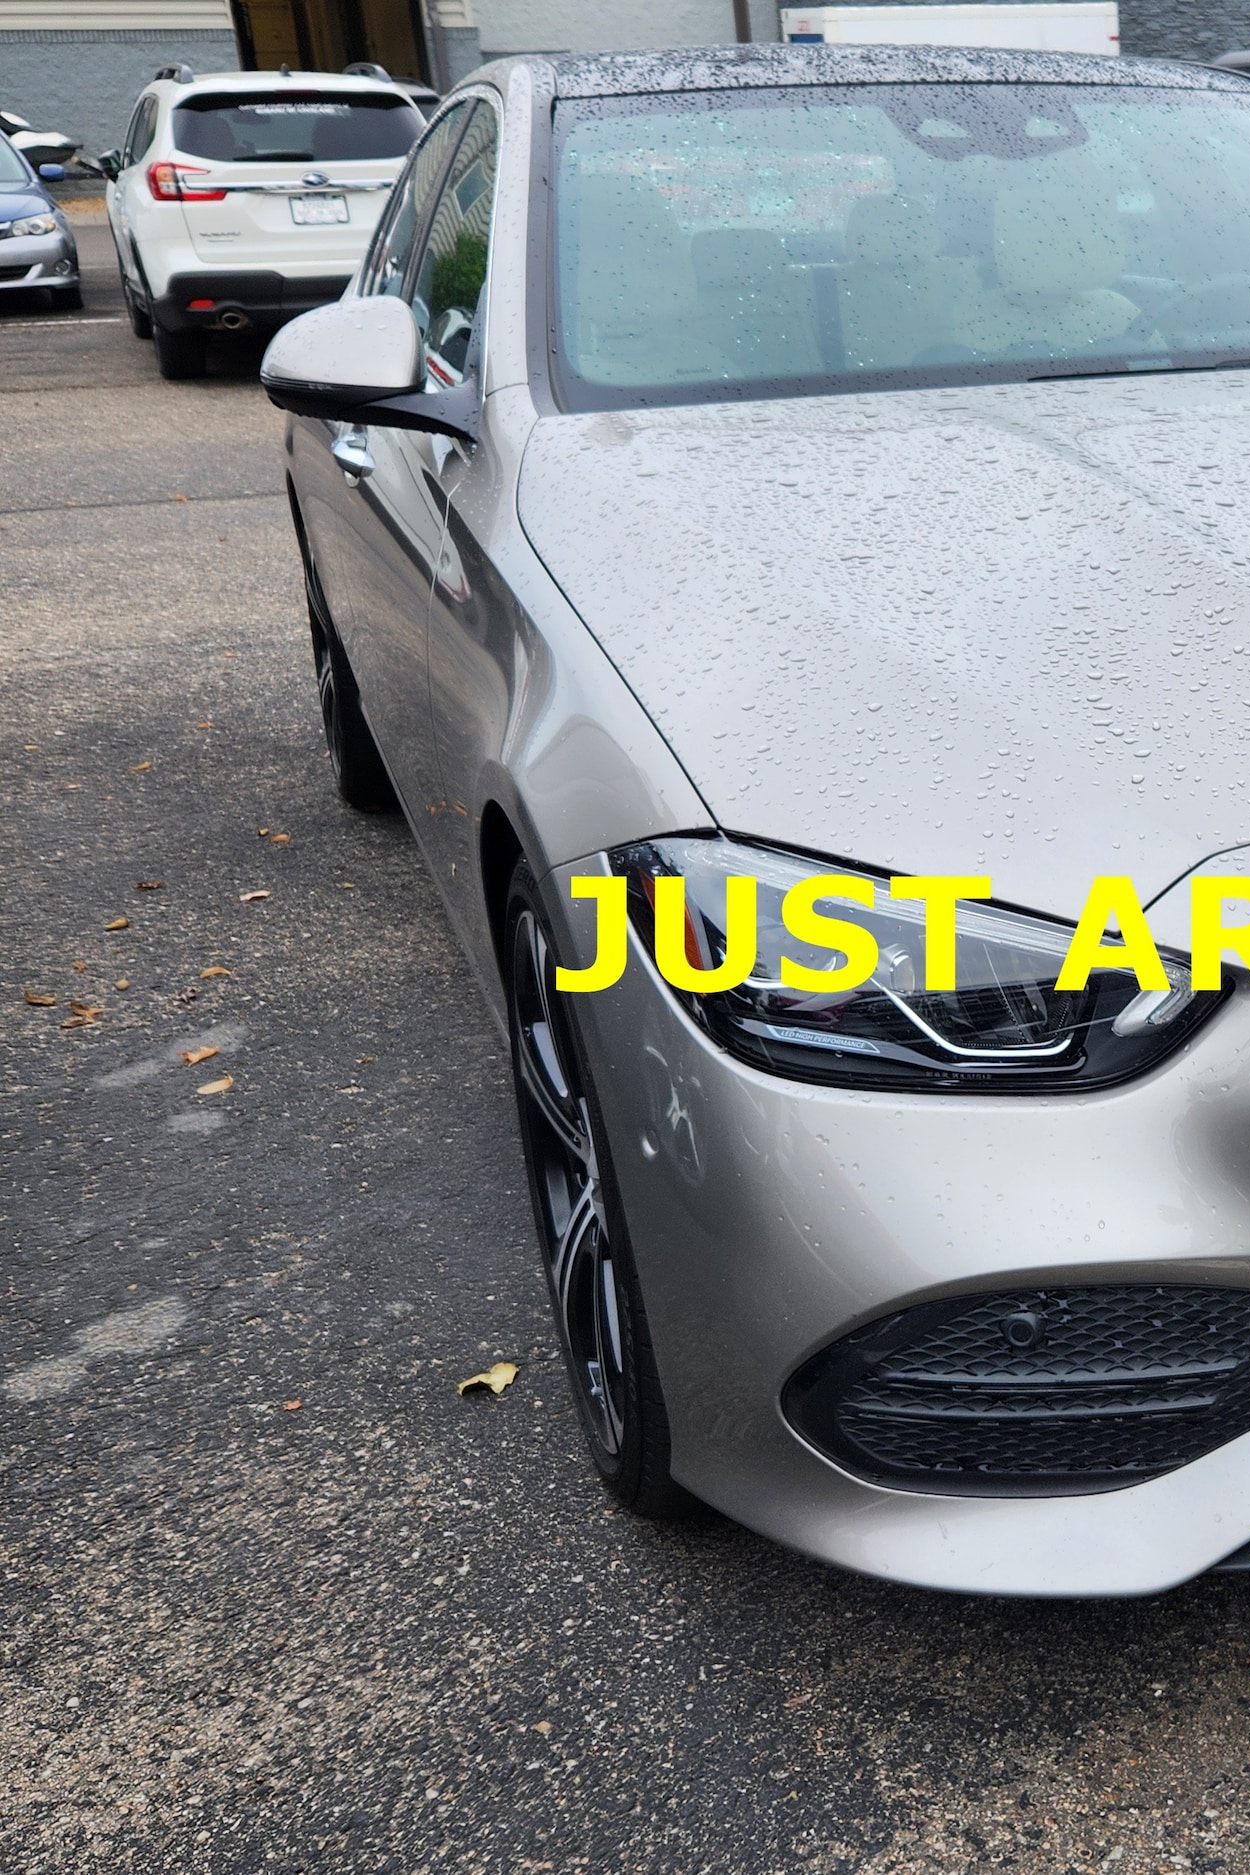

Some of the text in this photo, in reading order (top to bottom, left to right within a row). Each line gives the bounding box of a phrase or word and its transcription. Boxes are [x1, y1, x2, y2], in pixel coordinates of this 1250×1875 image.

[781, 1029, 865, 1049] LED HIGH PERFORMANCE
